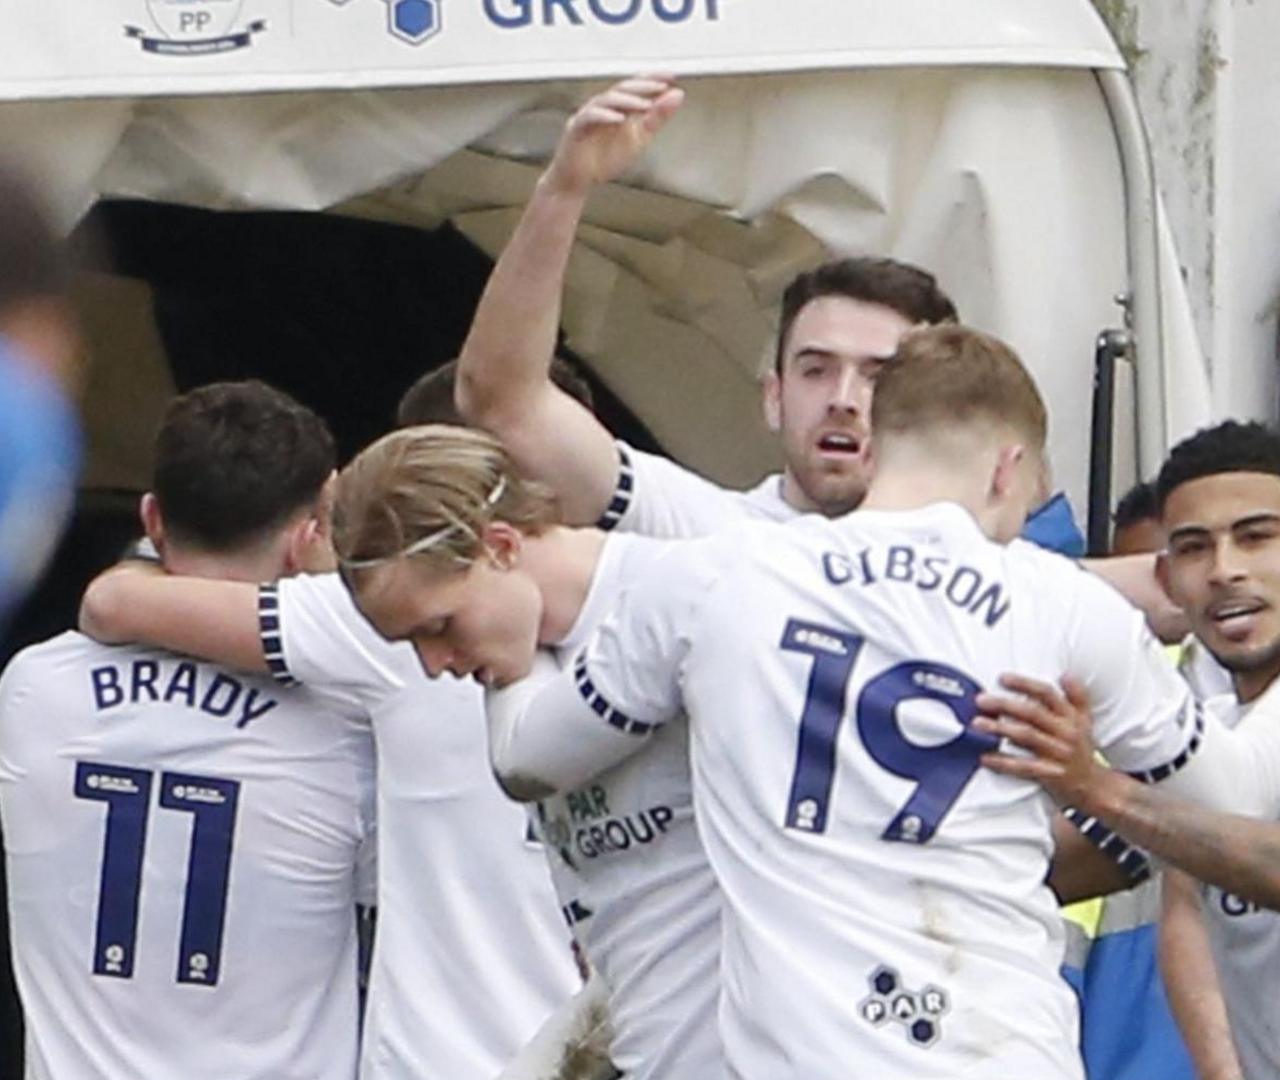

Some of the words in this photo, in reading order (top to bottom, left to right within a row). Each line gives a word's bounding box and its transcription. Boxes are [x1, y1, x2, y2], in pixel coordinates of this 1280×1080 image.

[179, 11, 211, 33] PP
[482, 0, 720, 29] GROU
[822, 545, 1012, 629] GIBSON
[91, 659, 279, 730] BRADY
[779, 616, 1002, 845] 19
[576, 805, 674, 859] GROUP
[73, 760, 241, 988] 11
[865, 991, 943, 1021] PAR
